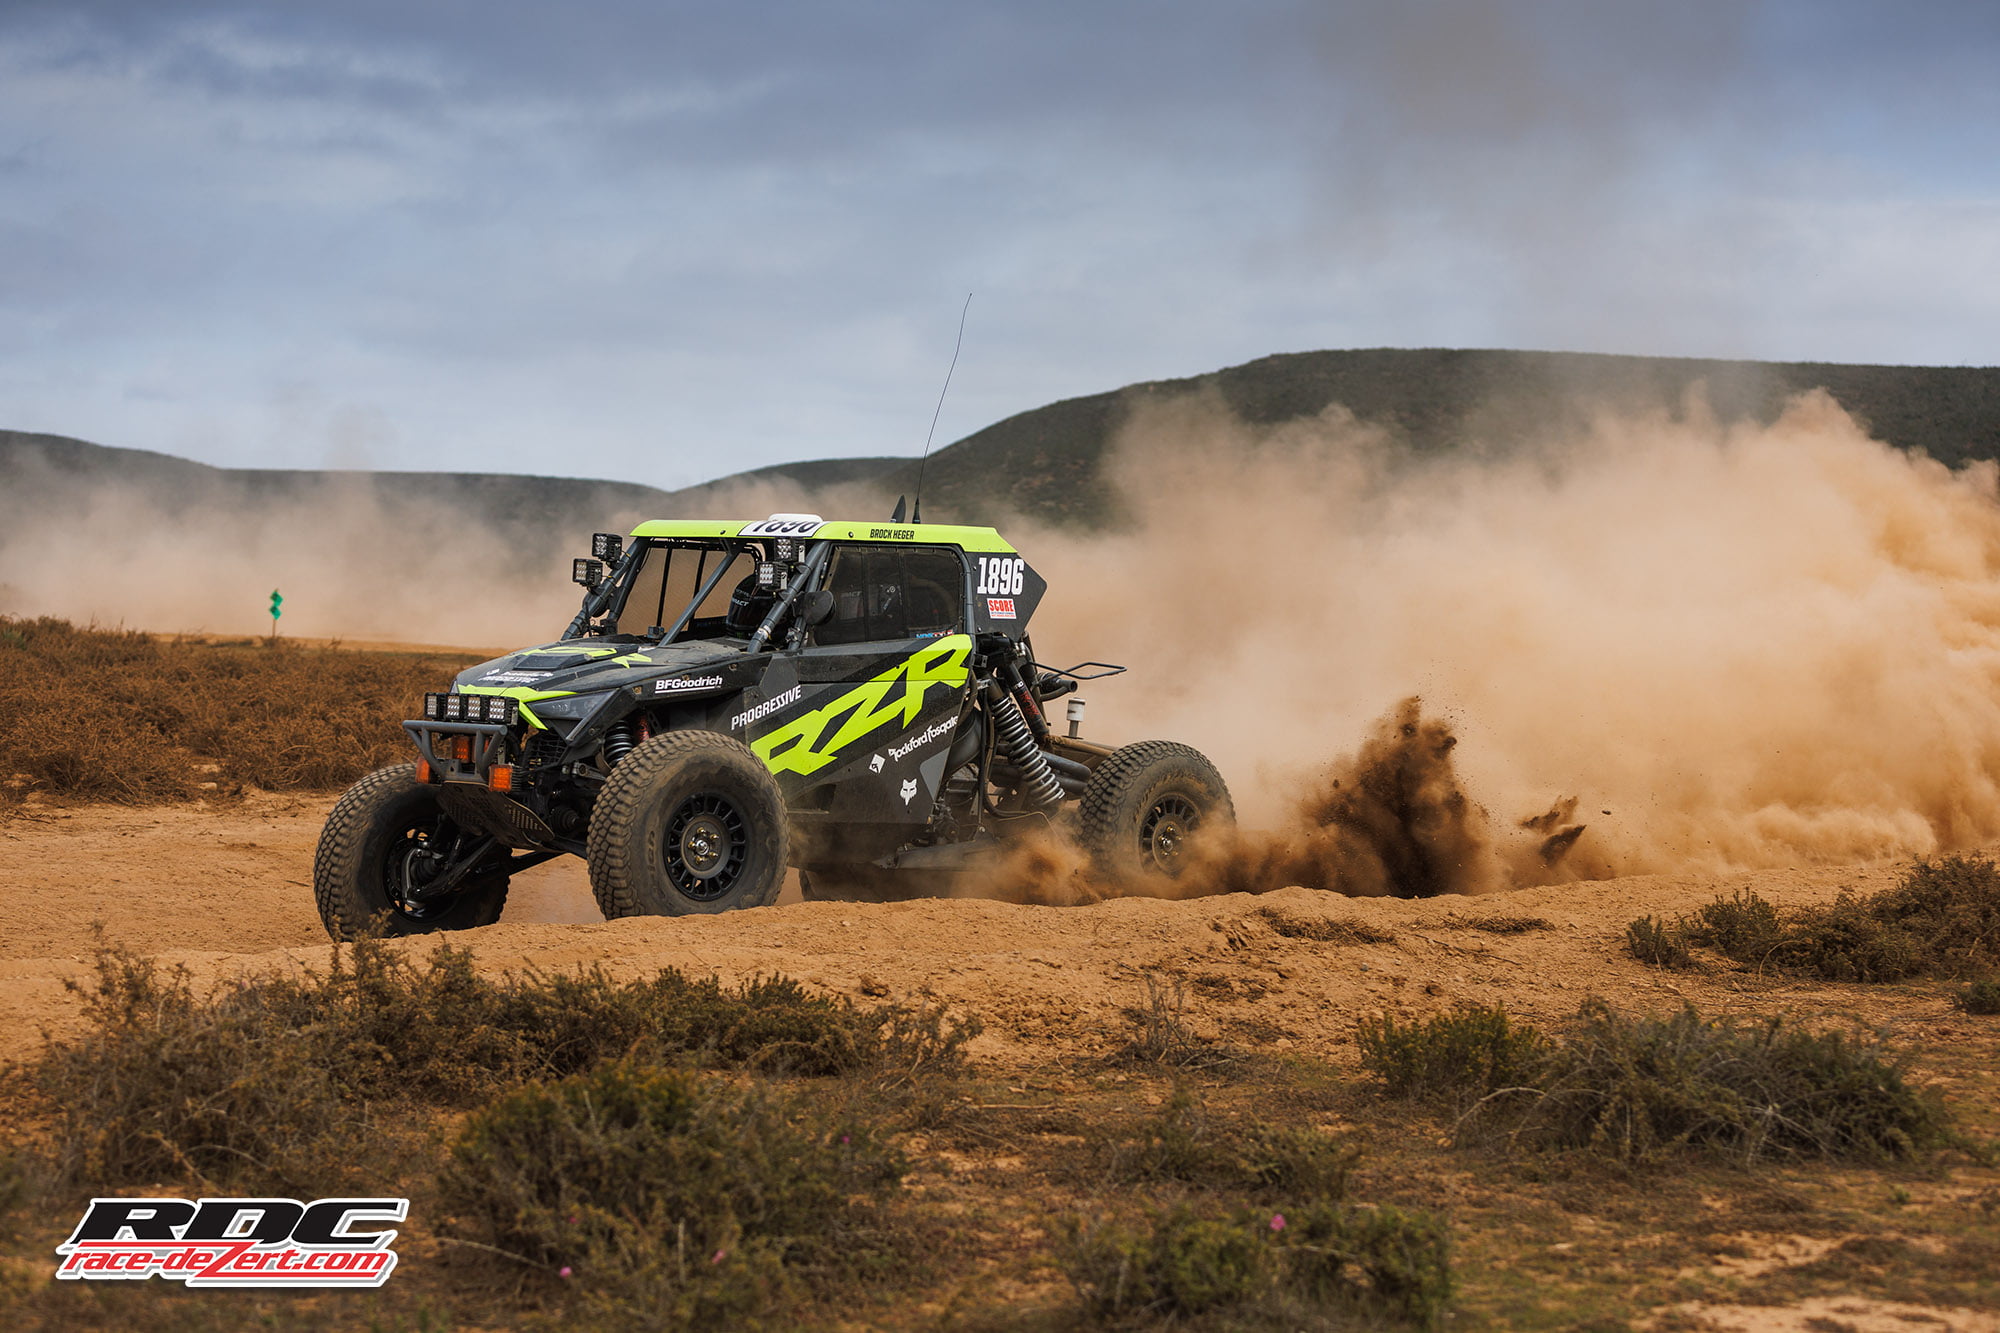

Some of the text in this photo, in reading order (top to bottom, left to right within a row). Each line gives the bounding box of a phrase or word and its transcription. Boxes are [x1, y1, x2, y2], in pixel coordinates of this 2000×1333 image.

[870, 529, 915, 540] BROCK HEGER
[977, 557, 1024, 595] 1896
[988, 599, 1014, 612] SCORE
[655, 675, 723, 690] BFGoodrich
[731, 685, 801, 730] PROGRESSIVE
[751, 634, 973, 776] RZR
[888, 715, 958, 762] Rockford Fosgate
